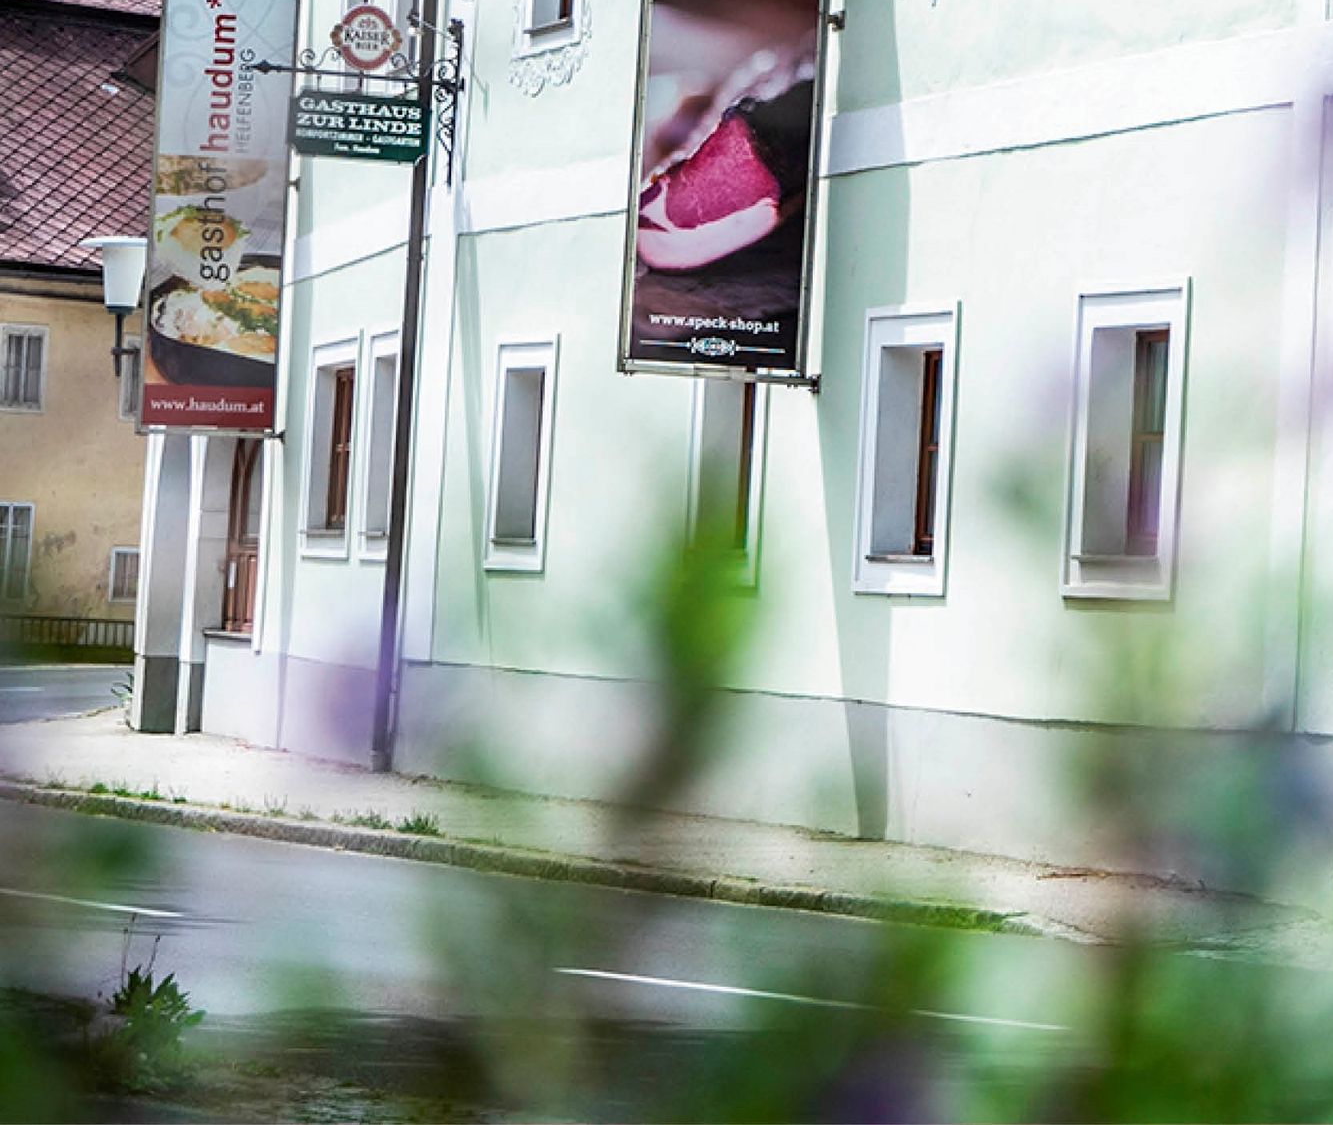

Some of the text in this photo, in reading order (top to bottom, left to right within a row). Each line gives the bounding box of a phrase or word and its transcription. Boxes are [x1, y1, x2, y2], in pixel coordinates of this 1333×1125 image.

[236, 48, 256, 154] HELFENBERG
[299, 97, 422, 120] GASTHAUS
[296, 113, 422, 135] ZUR LINDE
[198, 162, 231, 282] gasthof
[150, 397, 265, 413] www.haudum.at
